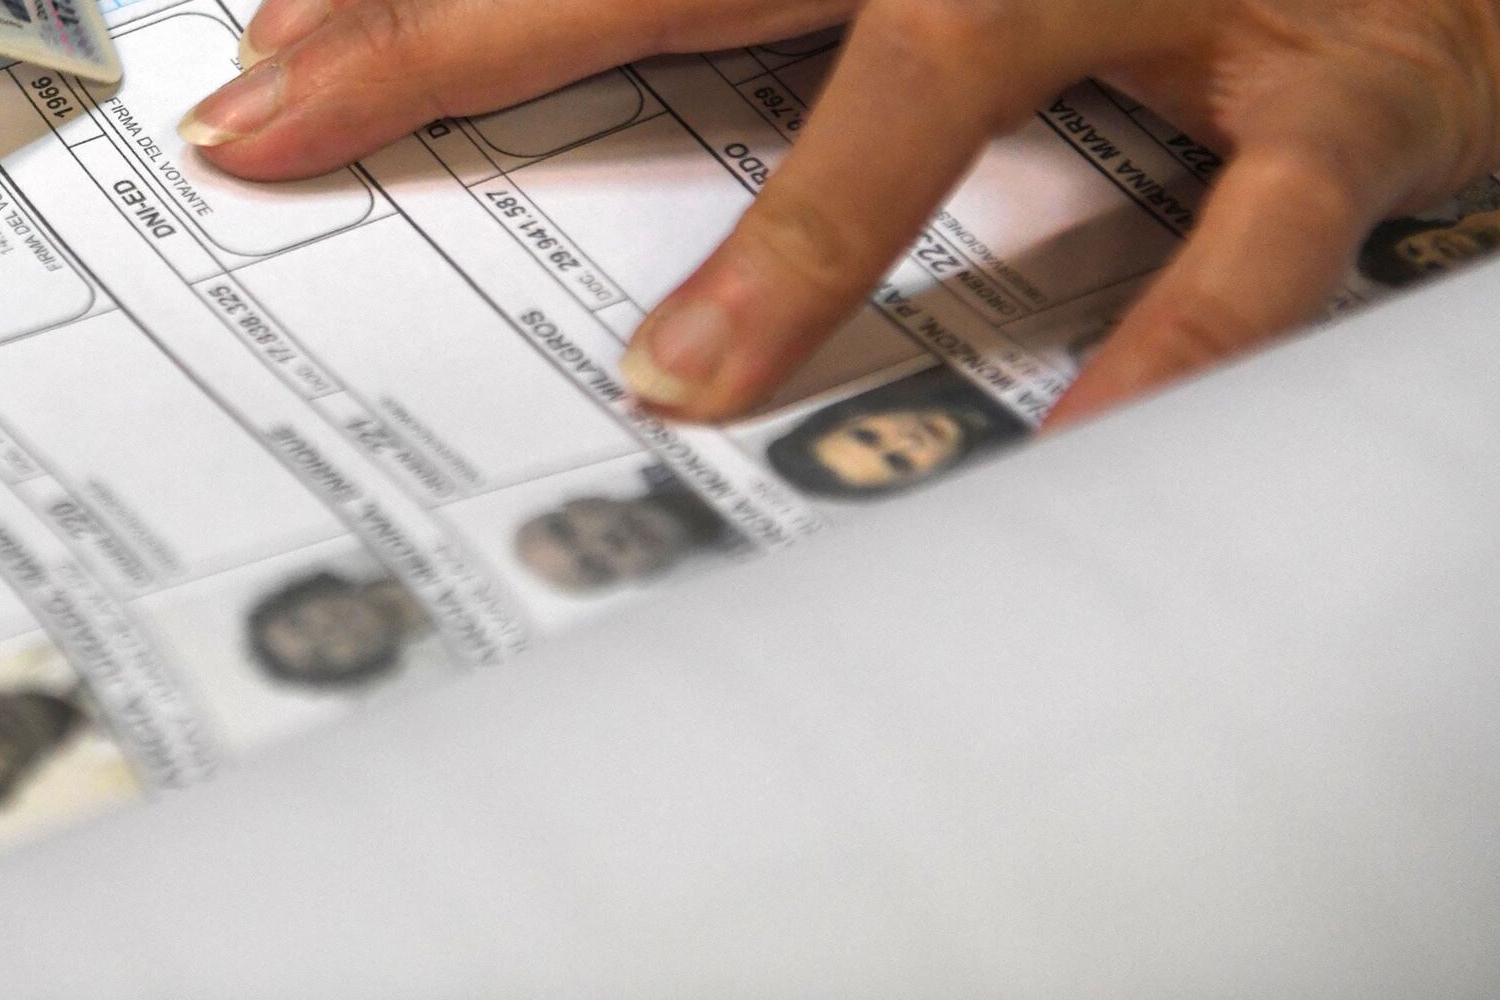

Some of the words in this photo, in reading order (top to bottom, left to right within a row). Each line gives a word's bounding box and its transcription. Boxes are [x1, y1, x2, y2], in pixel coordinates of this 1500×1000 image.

[27, 74, 78, 120] 1966
[101, 96, 143, 137] FIRMA
[133, 136, 165, 163] DEL
[155, 161, 214, 219] VOTANTE
[1043, 97, 1122, 162] MARIA
[0, 211, 31, 236] DEL
[109, 177, 176, 241] DNI-ED
[486, 185, 582, 272] 29.941.587
[574, 268, 614, 301] DOC.
[518, 307, 626, 405] MILAGROS
